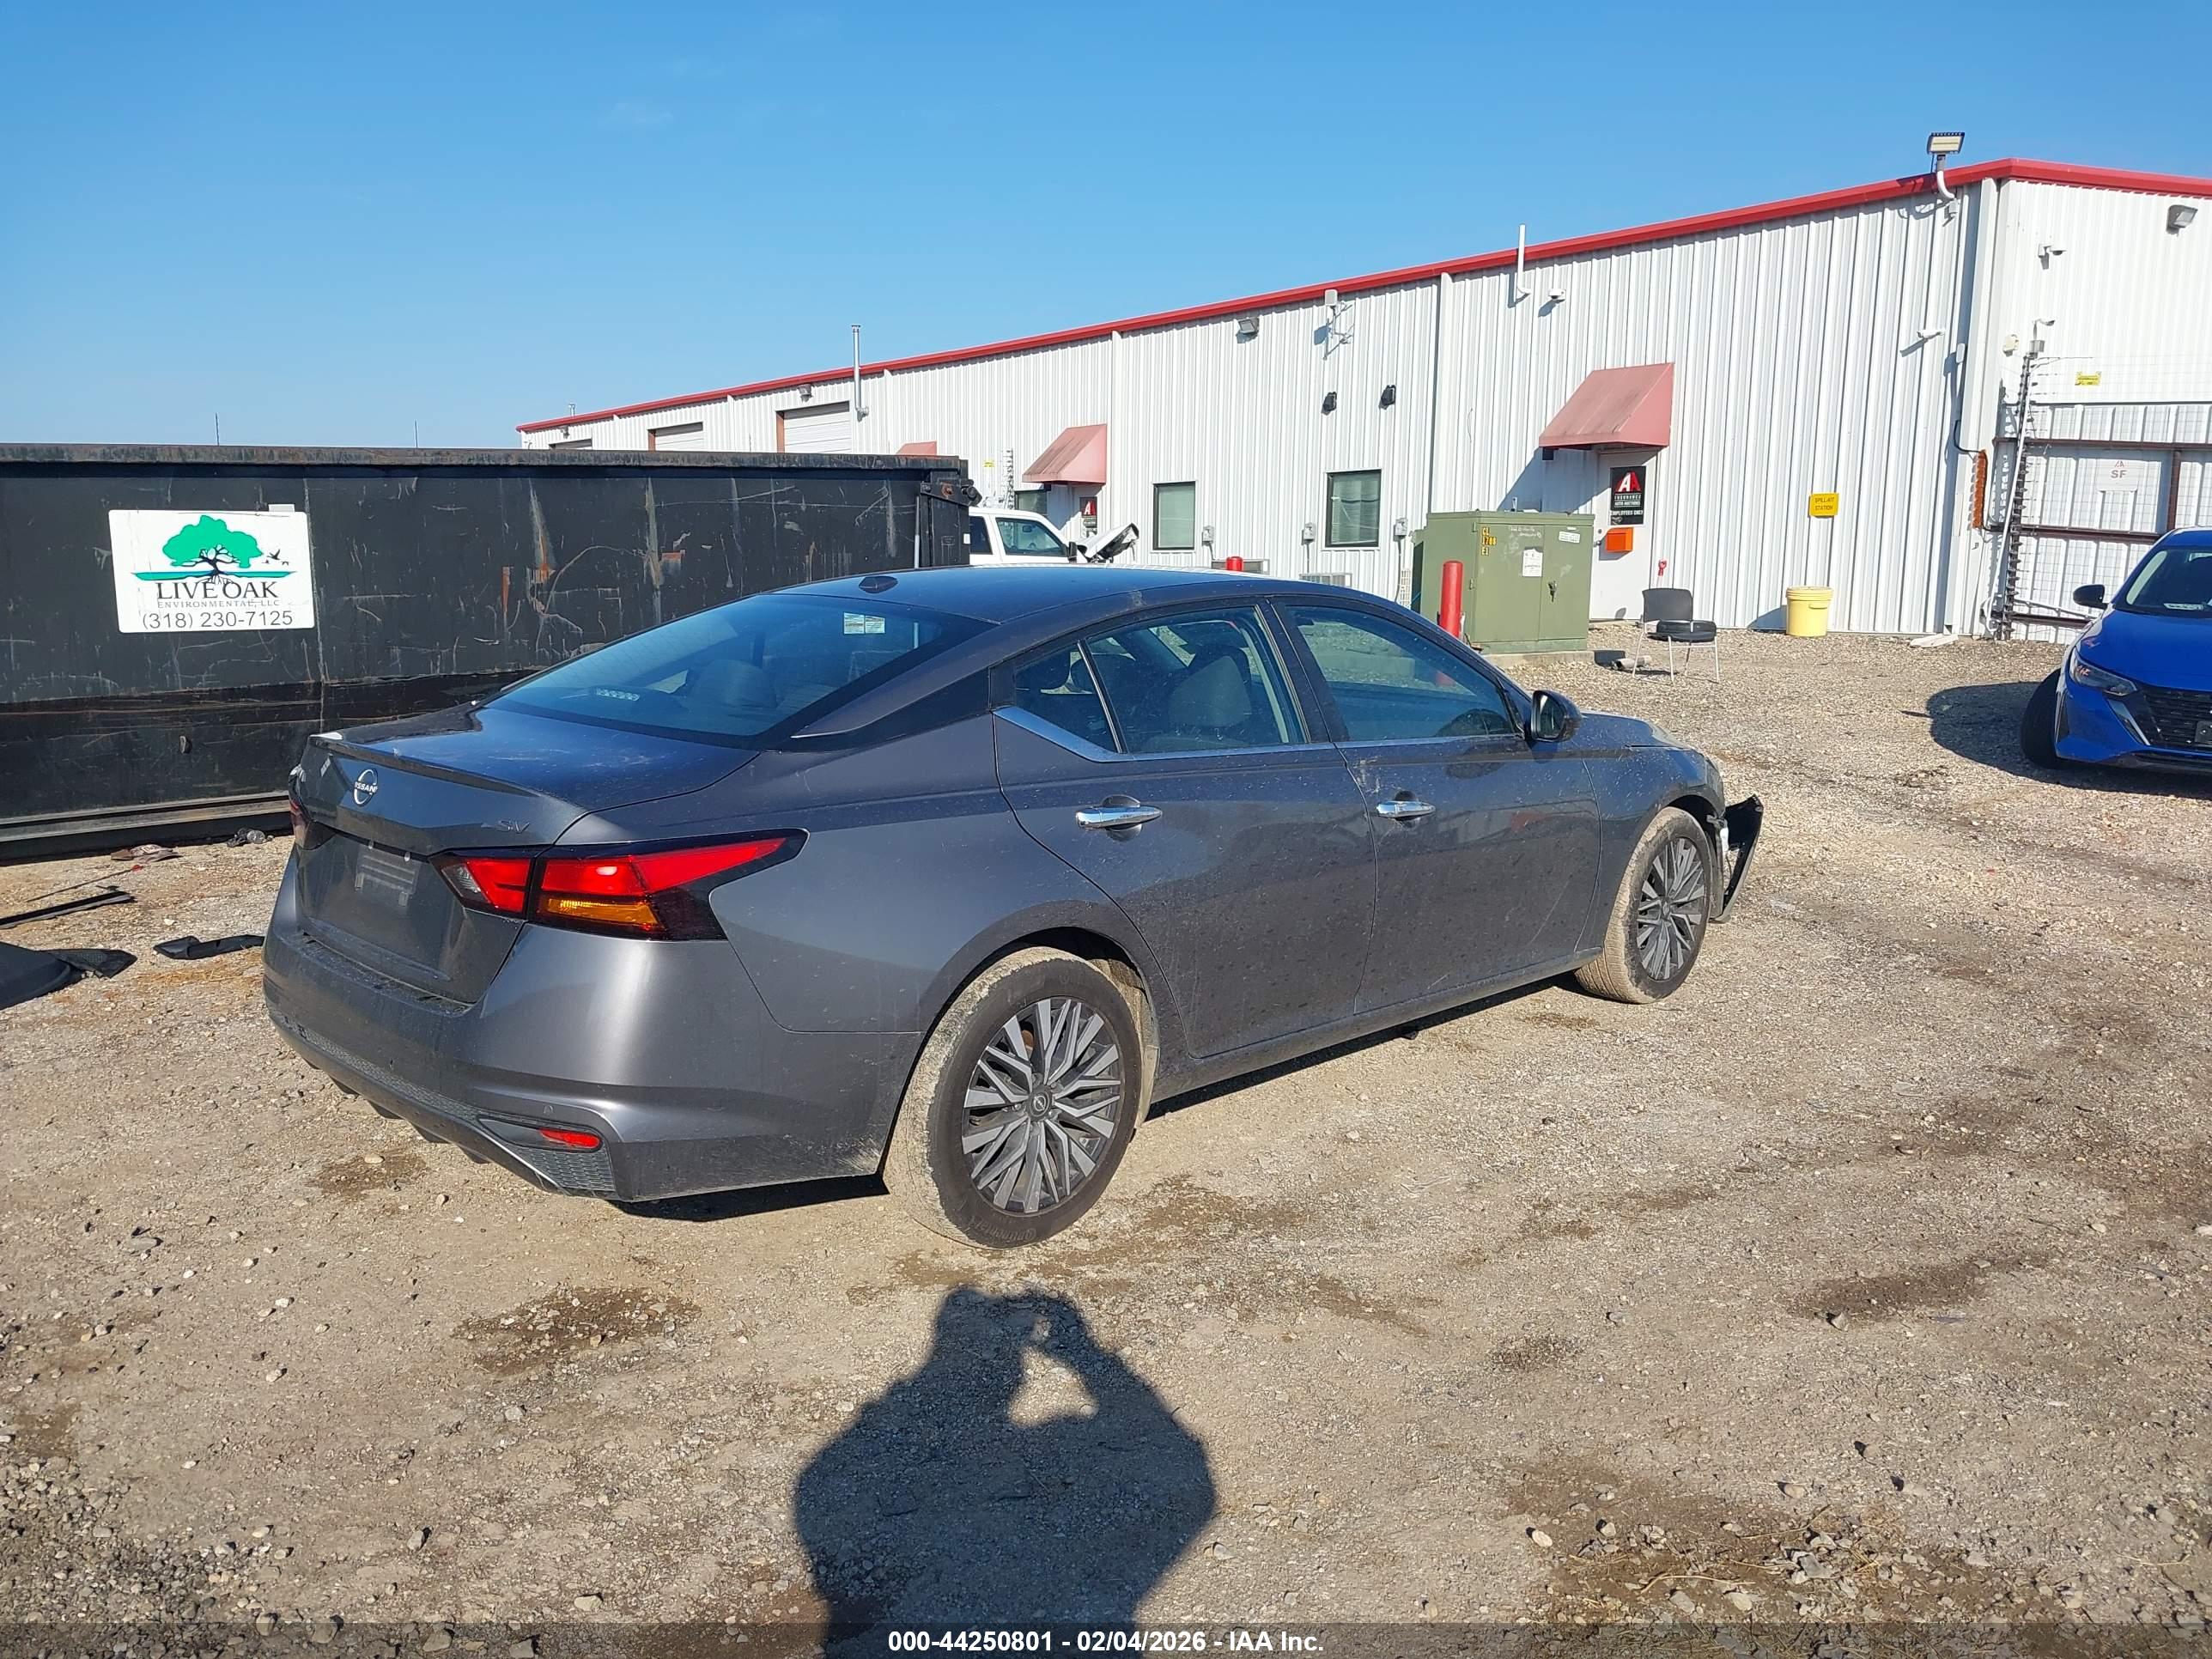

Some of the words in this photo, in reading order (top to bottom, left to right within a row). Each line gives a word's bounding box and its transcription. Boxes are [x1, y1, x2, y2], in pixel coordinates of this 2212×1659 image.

[2111, 470, 2127, 478] SF
[156, 581, 218, 599] LIVE
[222, 581, 279, 599] OAK
[143, 612, 193, 629] (318)
[201, 610, 294, 628] 230-7125
